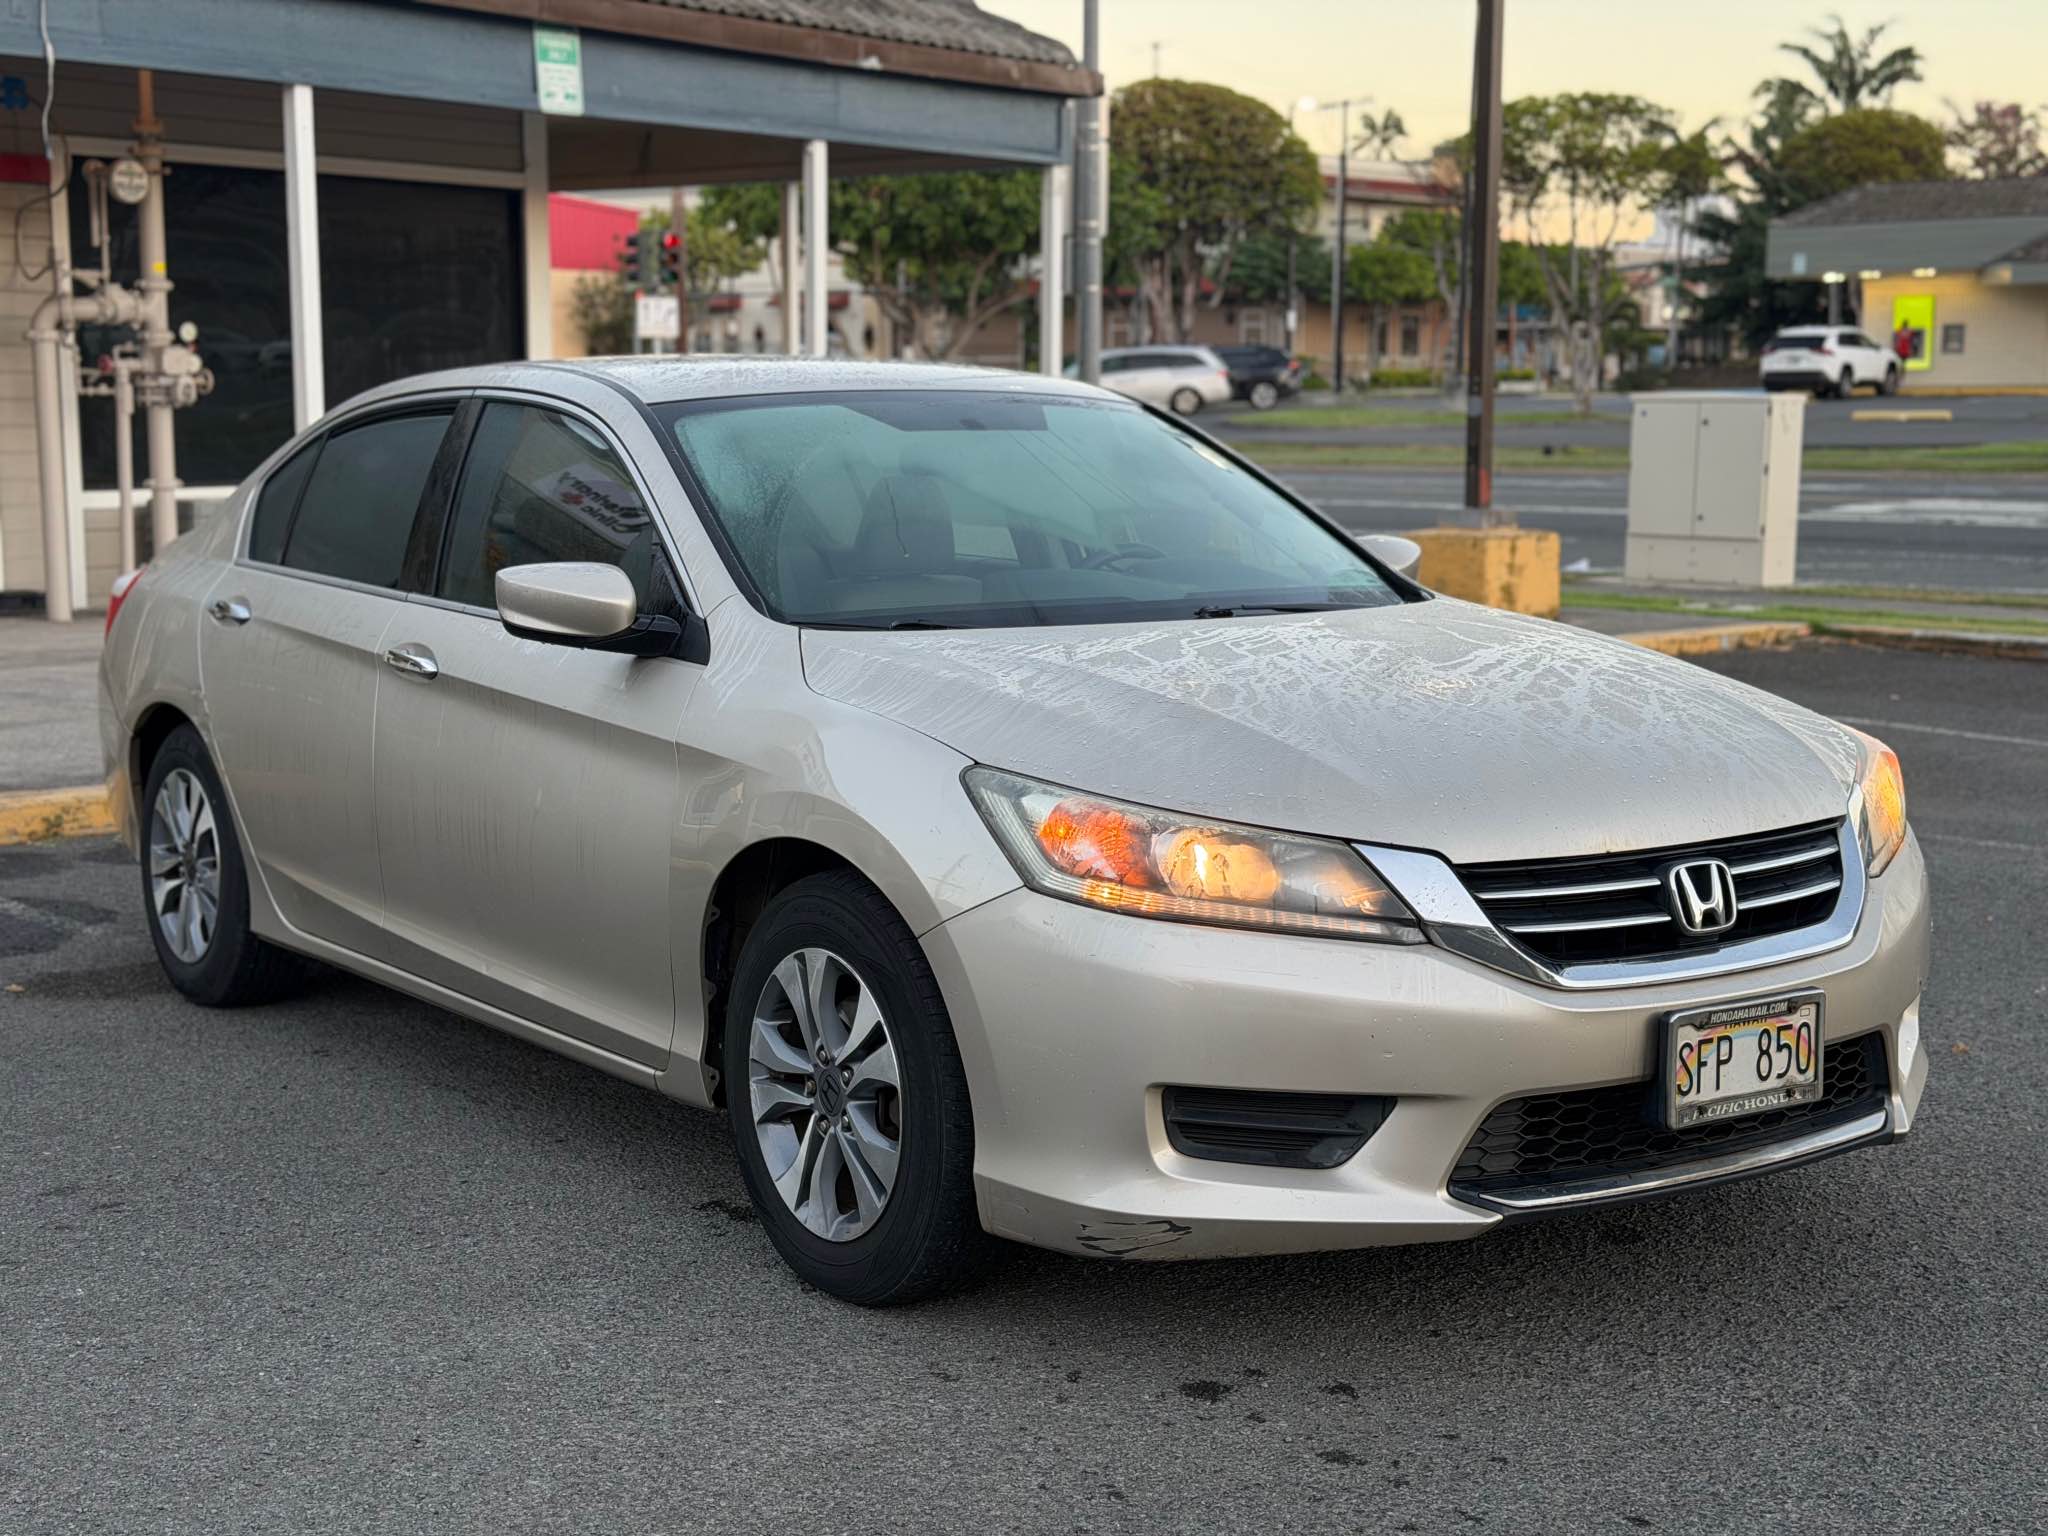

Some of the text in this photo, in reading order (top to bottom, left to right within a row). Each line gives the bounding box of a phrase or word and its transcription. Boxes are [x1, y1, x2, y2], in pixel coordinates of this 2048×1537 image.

[1710, 1001, 1789, 1024] HONDAHAWAII.COM
[1677, 1022, 1812, 1097] SFP 850
[1692, 1102, 1744, 1121] PCIFIC
